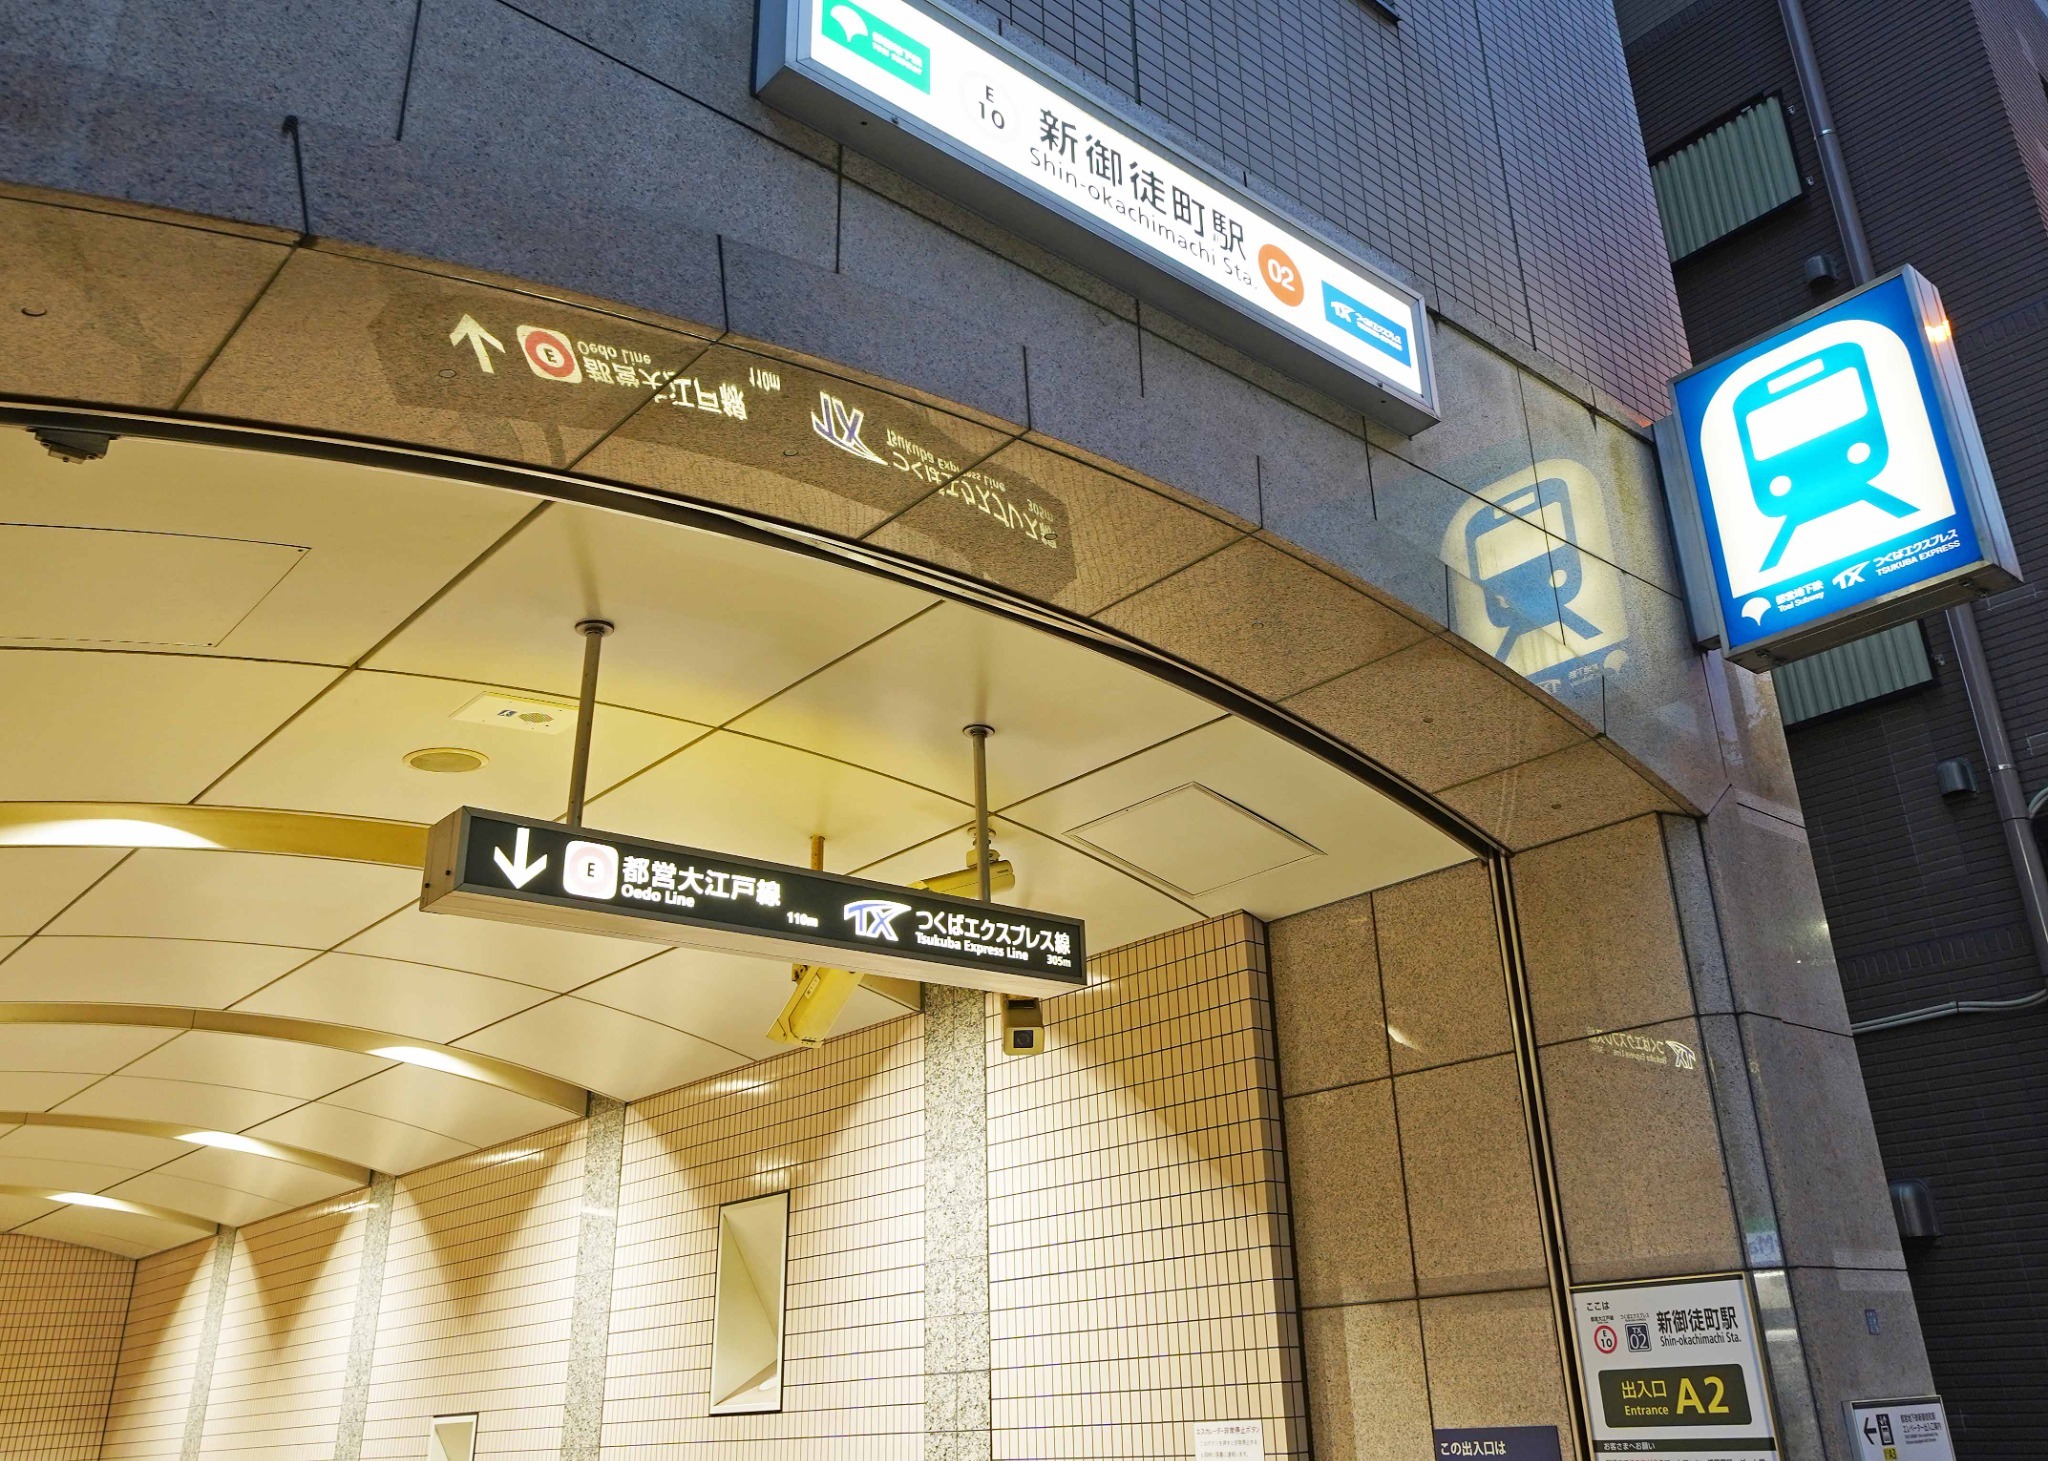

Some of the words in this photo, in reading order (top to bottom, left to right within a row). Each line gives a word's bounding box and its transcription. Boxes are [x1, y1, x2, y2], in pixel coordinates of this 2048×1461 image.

[985, 85, 994, 103] E
[978, 101, 1005, 130] 10
[1039, 108, 1246, 260] 新御徒町駅
[1030, 147, 1216, 266] Shin-okachimachi
[1223, 257, 1258, 290] Sta.
[1267, 258, 1296, 292] 02
[1876, 556, 1918, 576] TSUKUBA
[1919, 540, 1961, 561] EXPRESS
[1832, 560, 1870, 589] TX
[587, 862, 596, 877] E
[622, 855, 781, 908] 都営大江戸線
[621, 883, 662, 903] Oedo
[665, 889, 696, 908] Line
[786, 910, 820, 928] 110m
[843, 899, 912, 942] TX
[915, 910, 1071, 955] つくばエクスプレス線
[915, 931, 962, 950] Tsukuba
[964, 940, 1005, 958] Express
[1007, 946, 1029, 961] Line
[1046, 953, 1072, 968] 305m
[1586, 1301, 1610, 1311] ここは
[1656, 1306, 1739, 1334] 新御徒町駅
[1600, 1338, 1613, 1348] 10
[1629, 1334, 1648, 1349] 02
[1660, 1332, 1725, 1347] Shin-okachimachi
[1727, 1332, 1742, 1343] Sta.
[1621, 1380, 1667, 1399] 出入口
[1676, 1375, 1730, 1415] A2
[1624, 1405, 1669, 1416] Entrance
[1441, 1440, 1507, 1456] この出入口は
